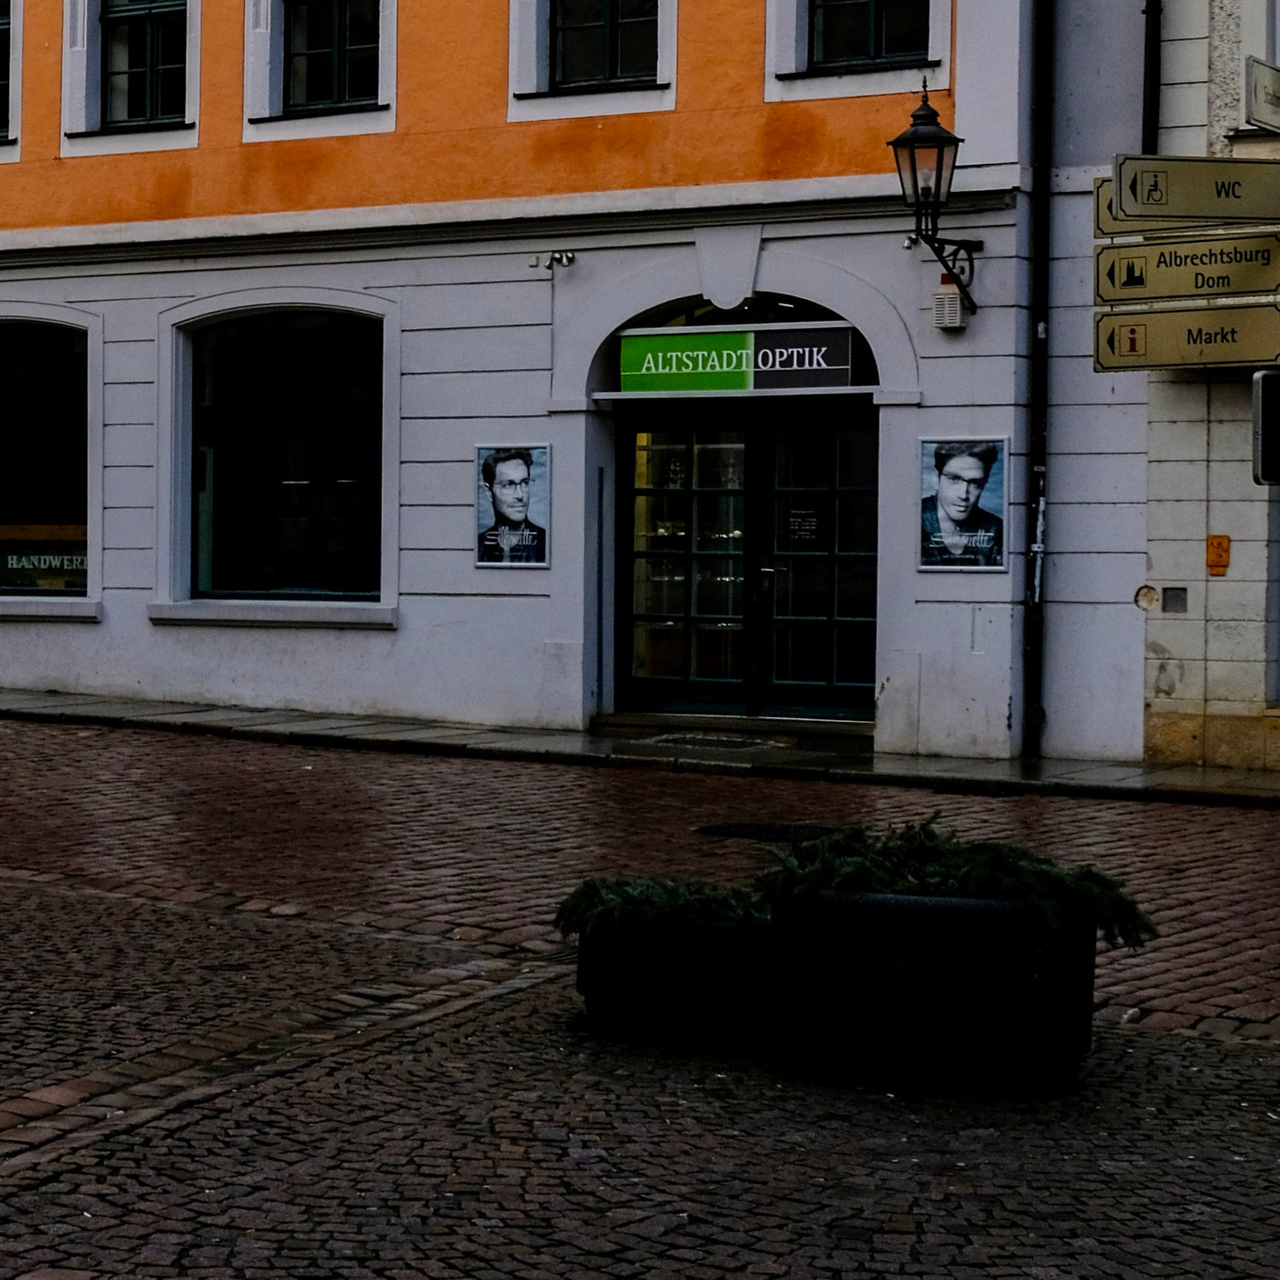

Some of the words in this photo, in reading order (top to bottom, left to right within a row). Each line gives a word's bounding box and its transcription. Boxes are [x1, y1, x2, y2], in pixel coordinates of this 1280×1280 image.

[1214, 181, 1242, 199] WC
[1156, 246, 1271, 268] Albrechtsburg
[1194, 272, 1231, 289] Dom
[1187, 327, 1238, 345] Markt
[640, 349, 752, 373] ALTSTADT
[757, 347, 829, 370] OPTIK
